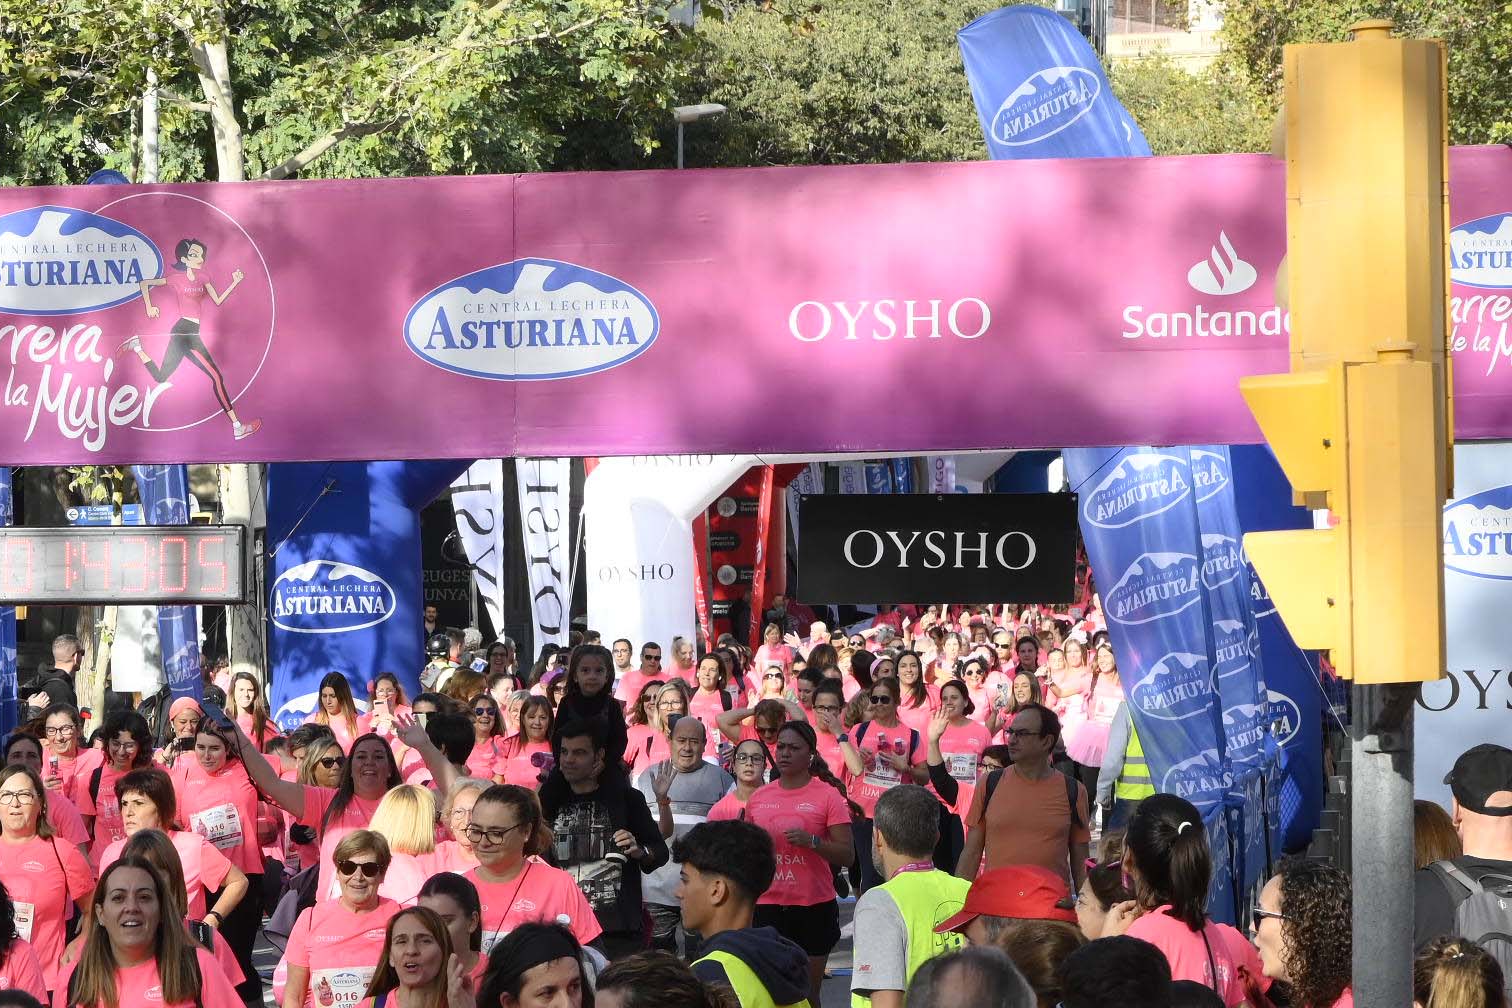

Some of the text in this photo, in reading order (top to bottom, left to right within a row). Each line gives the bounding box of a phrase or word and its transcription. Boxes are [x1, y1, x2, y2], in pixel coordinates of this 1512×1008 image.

[64, 242, 139, 255] LECHERA
[463, 298, 632, 315] CENTRAL LECHERA
[420, 306, 637, 351] ASTURIANA
[787, 297, 993, 344] OYSHO
[1473, 325, 1491, 352] la
[3, 371, 29, 407] la
[24, 359, 172, 453] Mujer
[842, 529, 1038, 571] OYSHO
[286, 583, 382, 594] CENTRAL LECHERA
[273, 593, 387, 617] ASTURIANA
[335, 991, 358, 1002] 016
